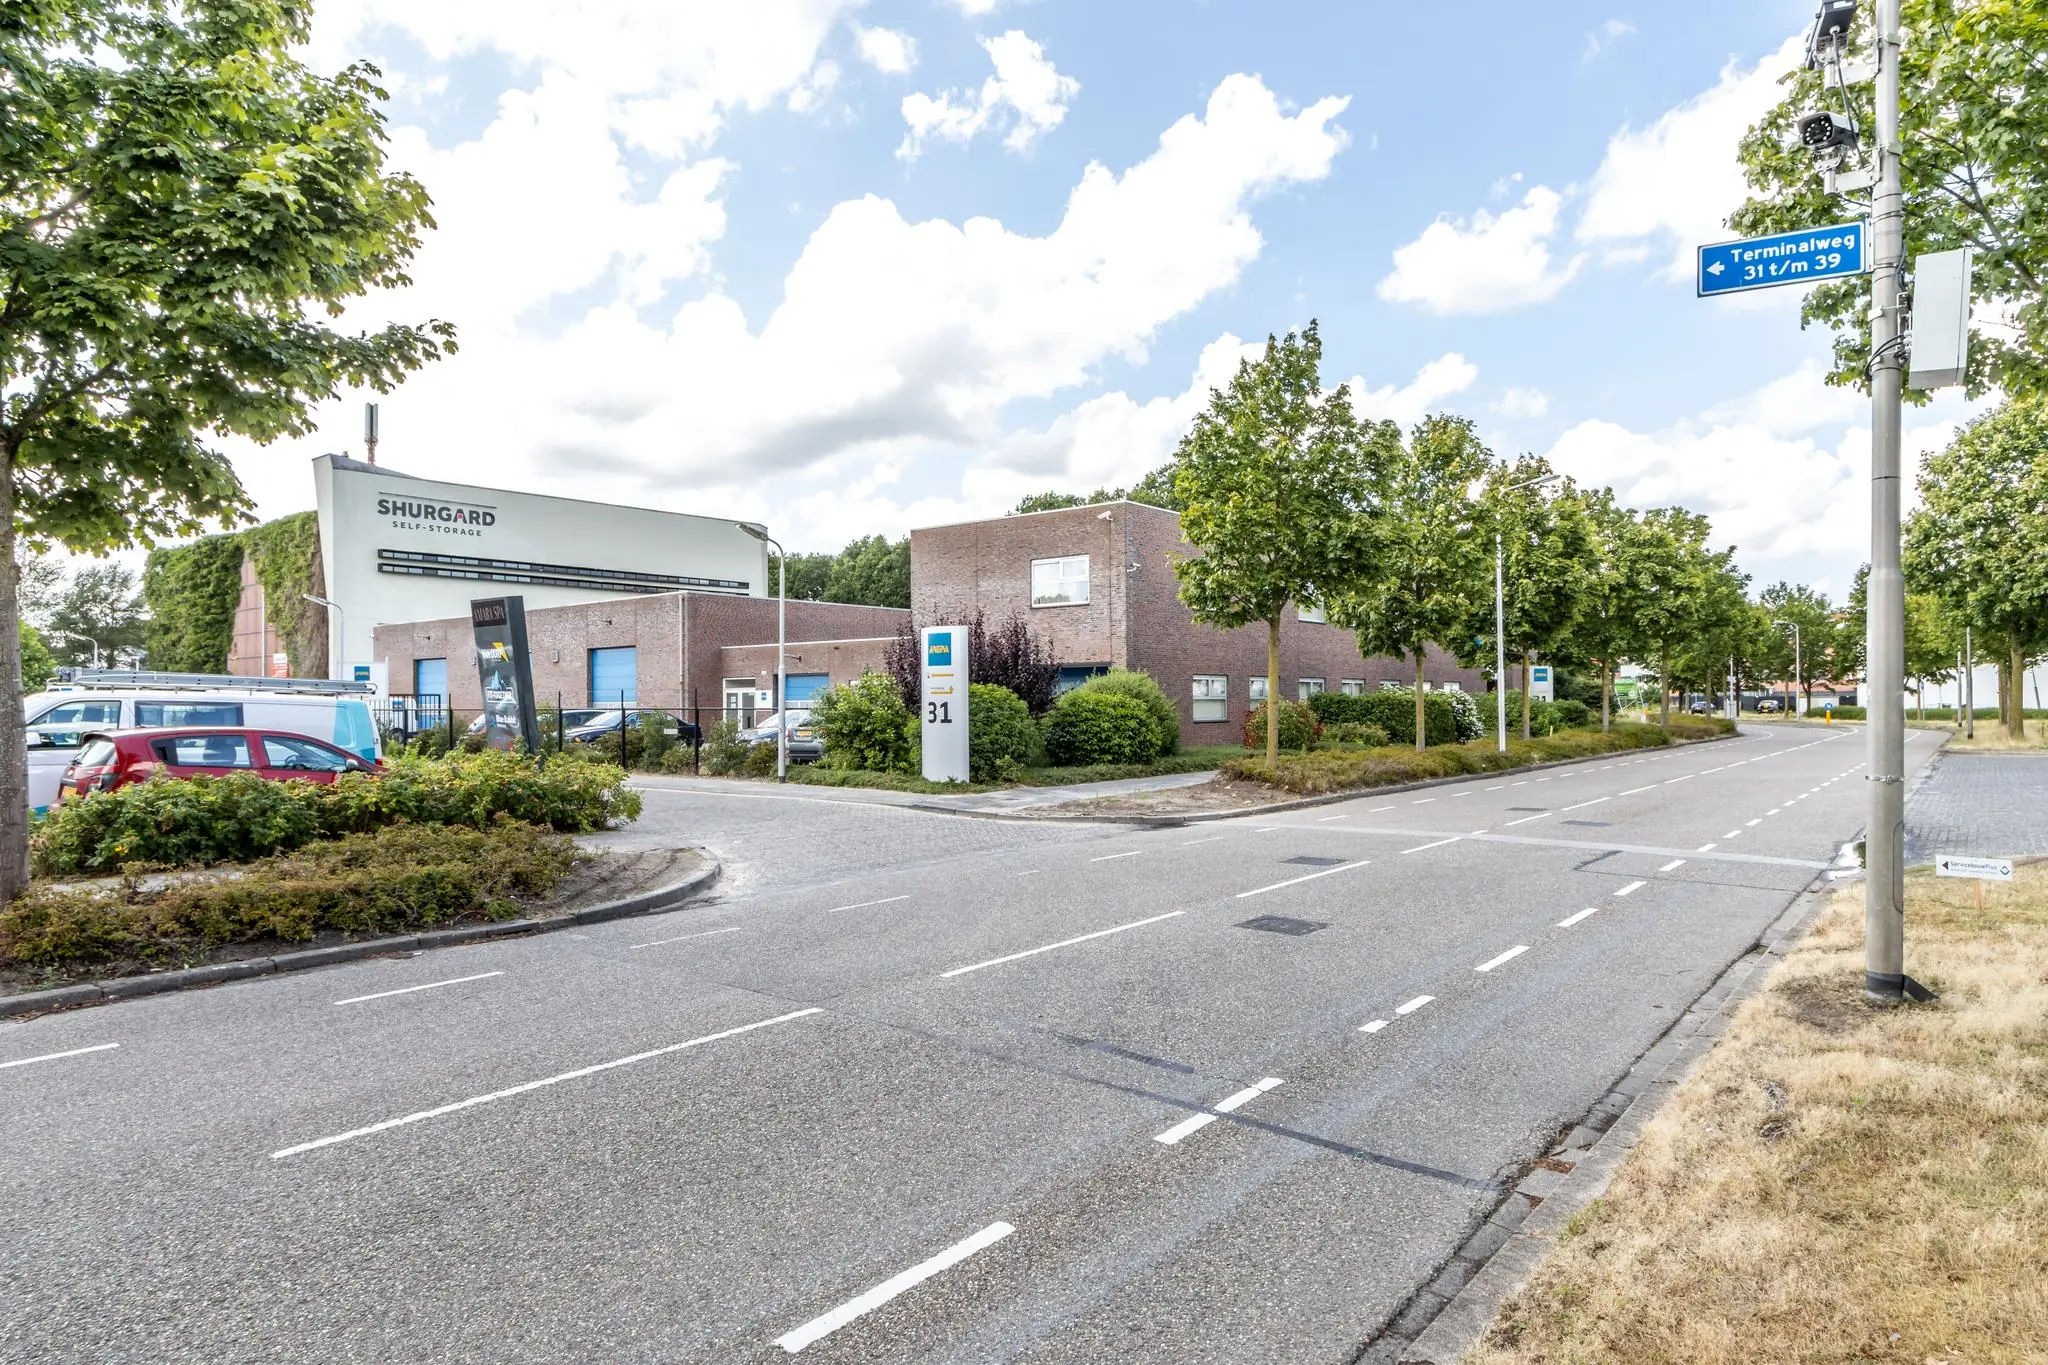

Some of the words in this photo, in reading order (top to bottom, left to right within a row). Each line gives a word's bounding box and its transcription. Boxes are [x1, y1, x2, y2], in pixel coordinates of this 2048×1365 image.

[1731, 234, 1855, 263] Terminalweg
[1744, 264, 1763, 280] 31
[1769, 260, 1808, 276] t/m
[1815, 253, 1841, 270] 39
[377, 499, 496, 527] SHURGARD
[392, 521, 482, 536] SELF-STORAGE
[928, 701, 952, 723] 31
